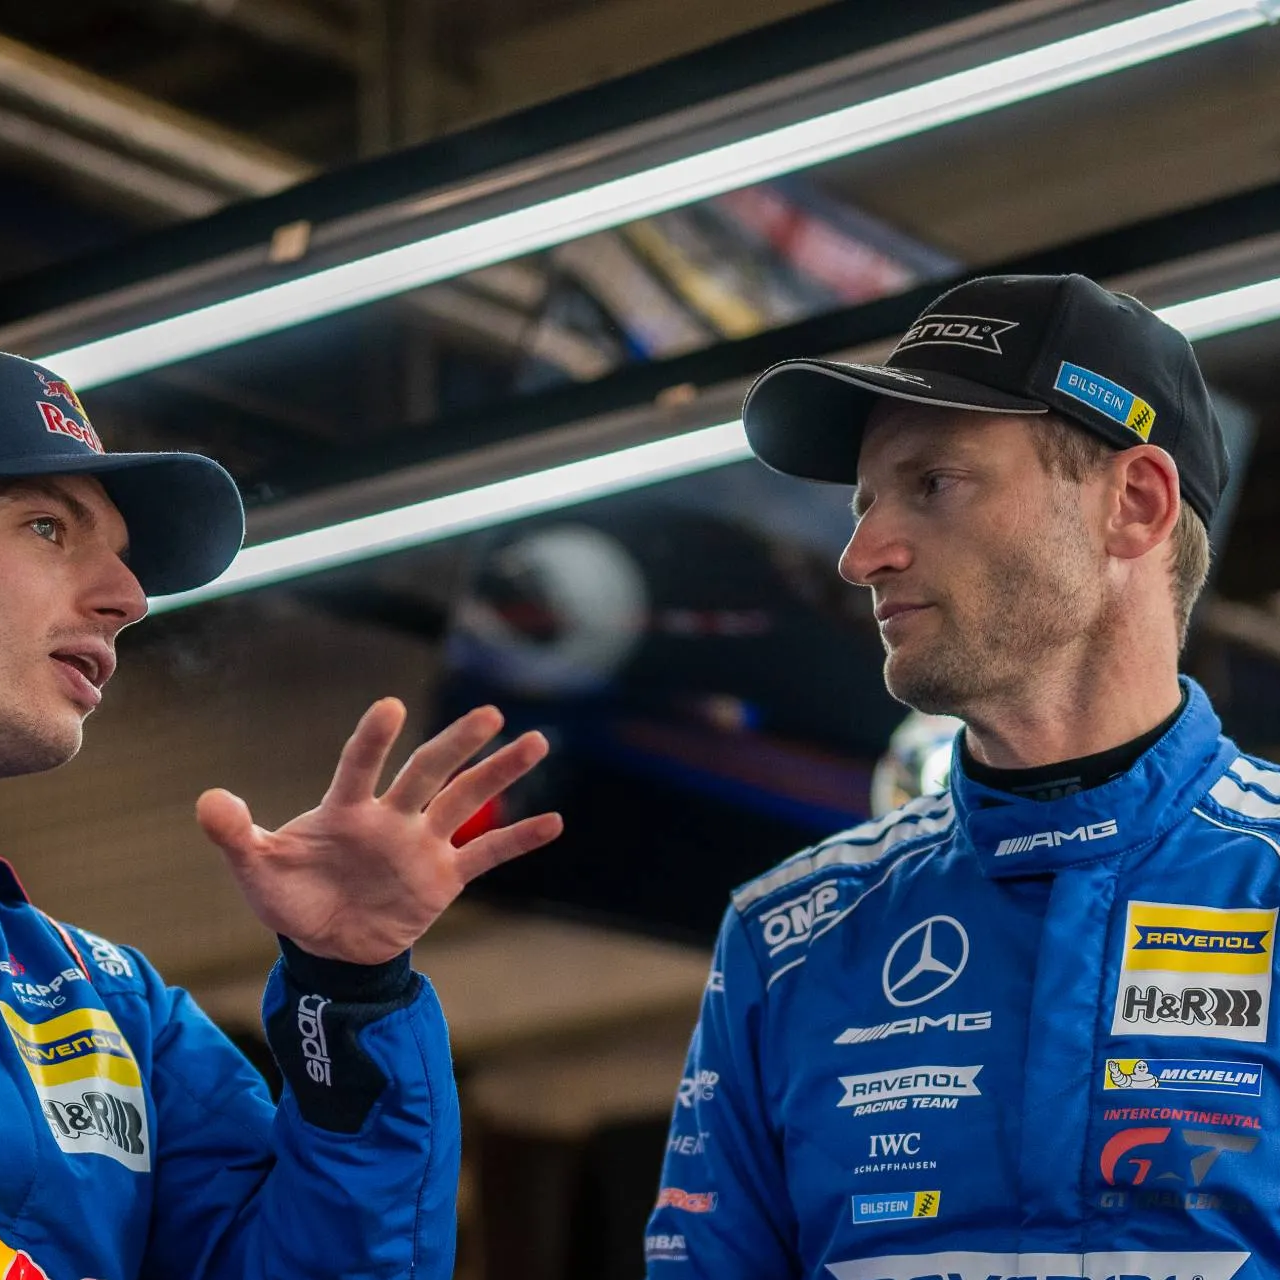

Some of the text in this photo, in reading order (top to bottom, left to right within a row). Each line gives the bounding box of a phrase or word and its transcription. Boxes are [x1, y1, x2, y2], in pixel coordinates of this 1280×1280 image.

[1067, 373, 1125, 411] BILSTEIN
[763, 887, 839, 945] OMP
[1146, 932, 1256, 949] RAVENOL
[1122, 984, 1215, 1026] H&R
[852, 1074, 967, 1098] RAVENOL
[1159, 1068, 1258, 1085] MICHELIN
[853, 1097, 958, 1117] RACING TEAM
[1104, 1107, 1262, 1129] INTERCONTINENTAL
[869, 1132, 920, 1157] IWC
[854, 1161, 937, 1175] SCHAFFHAUSEN
[860, 1200, 908, 1214] BILSTEIN
